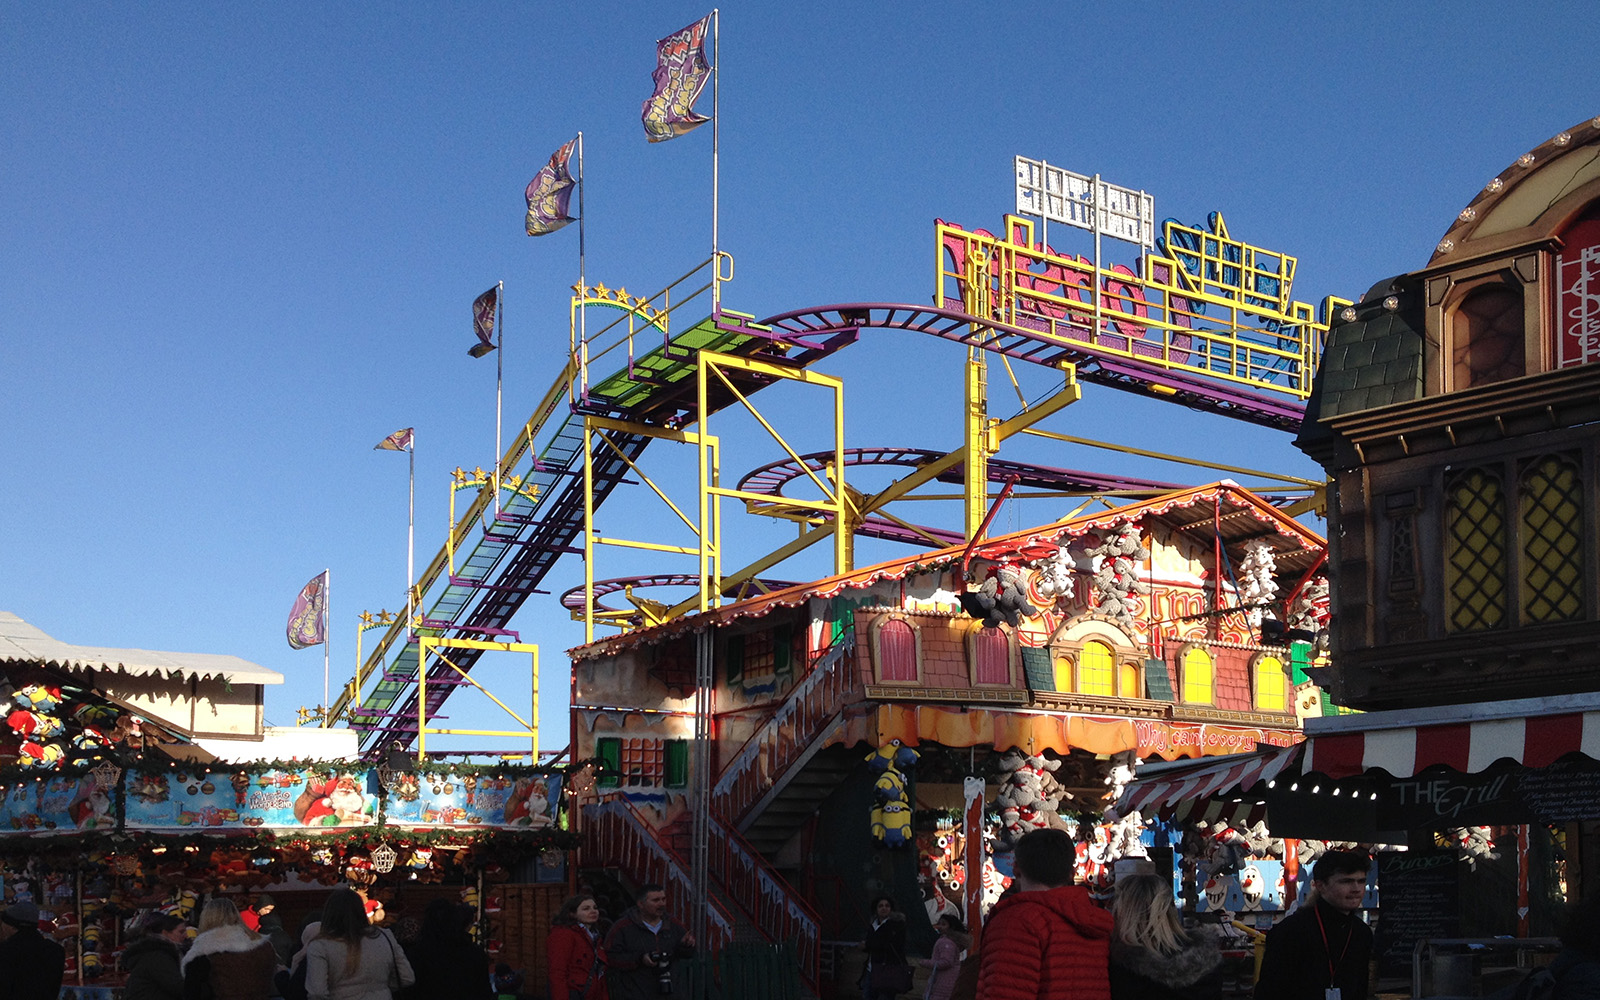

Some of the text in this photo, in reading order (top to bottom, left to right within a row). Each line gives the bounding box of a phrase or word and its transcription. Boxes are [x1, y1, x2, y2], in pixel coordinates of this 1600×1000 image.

[1136, 721, 1167, 752] Why
[1208, 733, 1255, 752] every
[1390, 773, 1509, 818] THE Grill
[1381, 854, 1454, 874] Burgers
